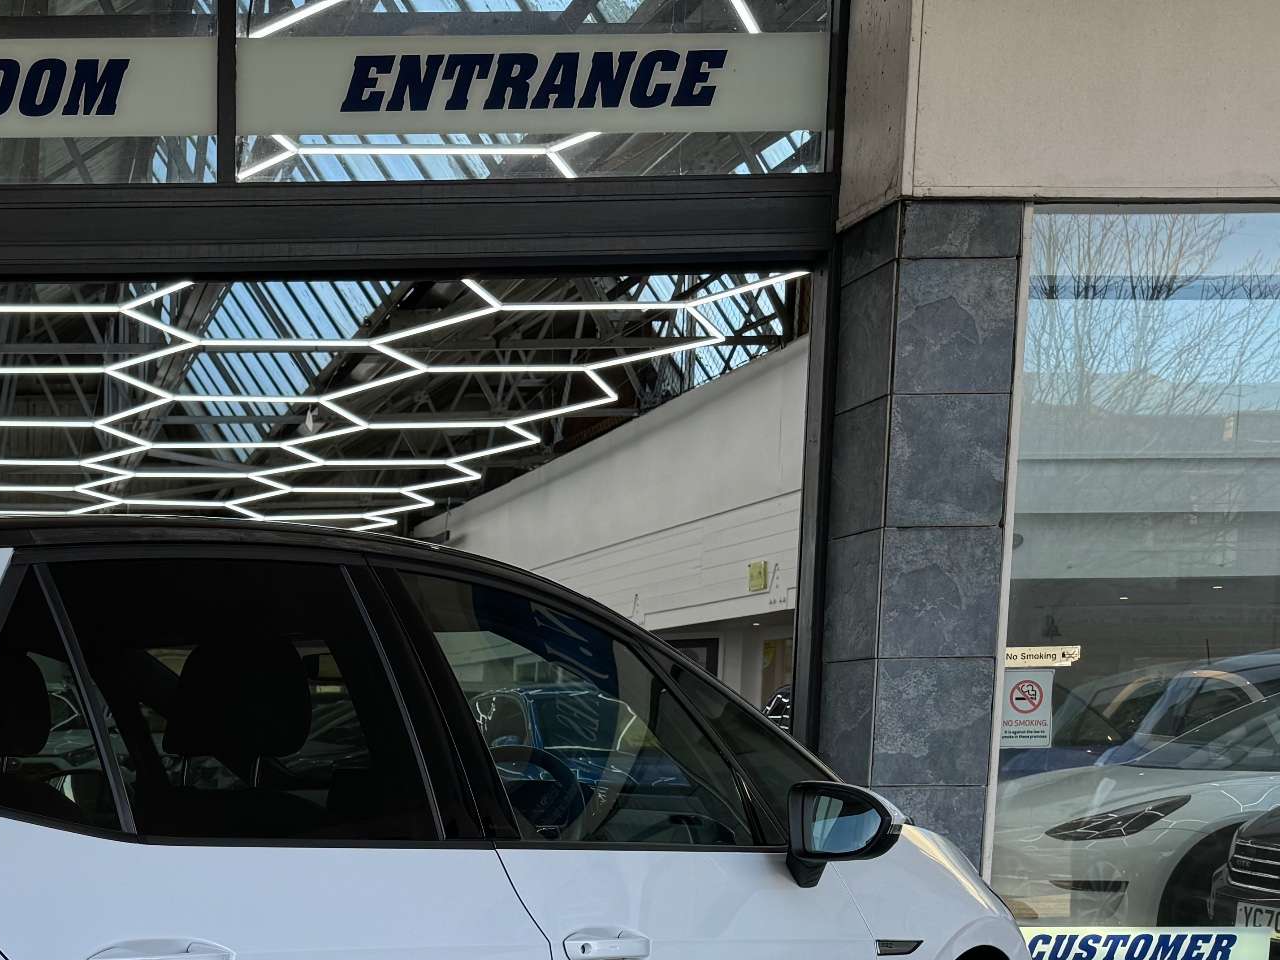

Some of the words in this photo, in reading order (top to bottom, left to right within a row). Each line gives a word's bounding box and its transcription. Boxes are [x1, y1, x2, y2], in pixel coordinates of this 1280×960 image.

[339, 48, 729, 113] ENTRANCE
[1006, 652, 1018, 661] No
[1020, 652, 1057, 661] Smoking
[1002, 719, 1012, 727] NO
